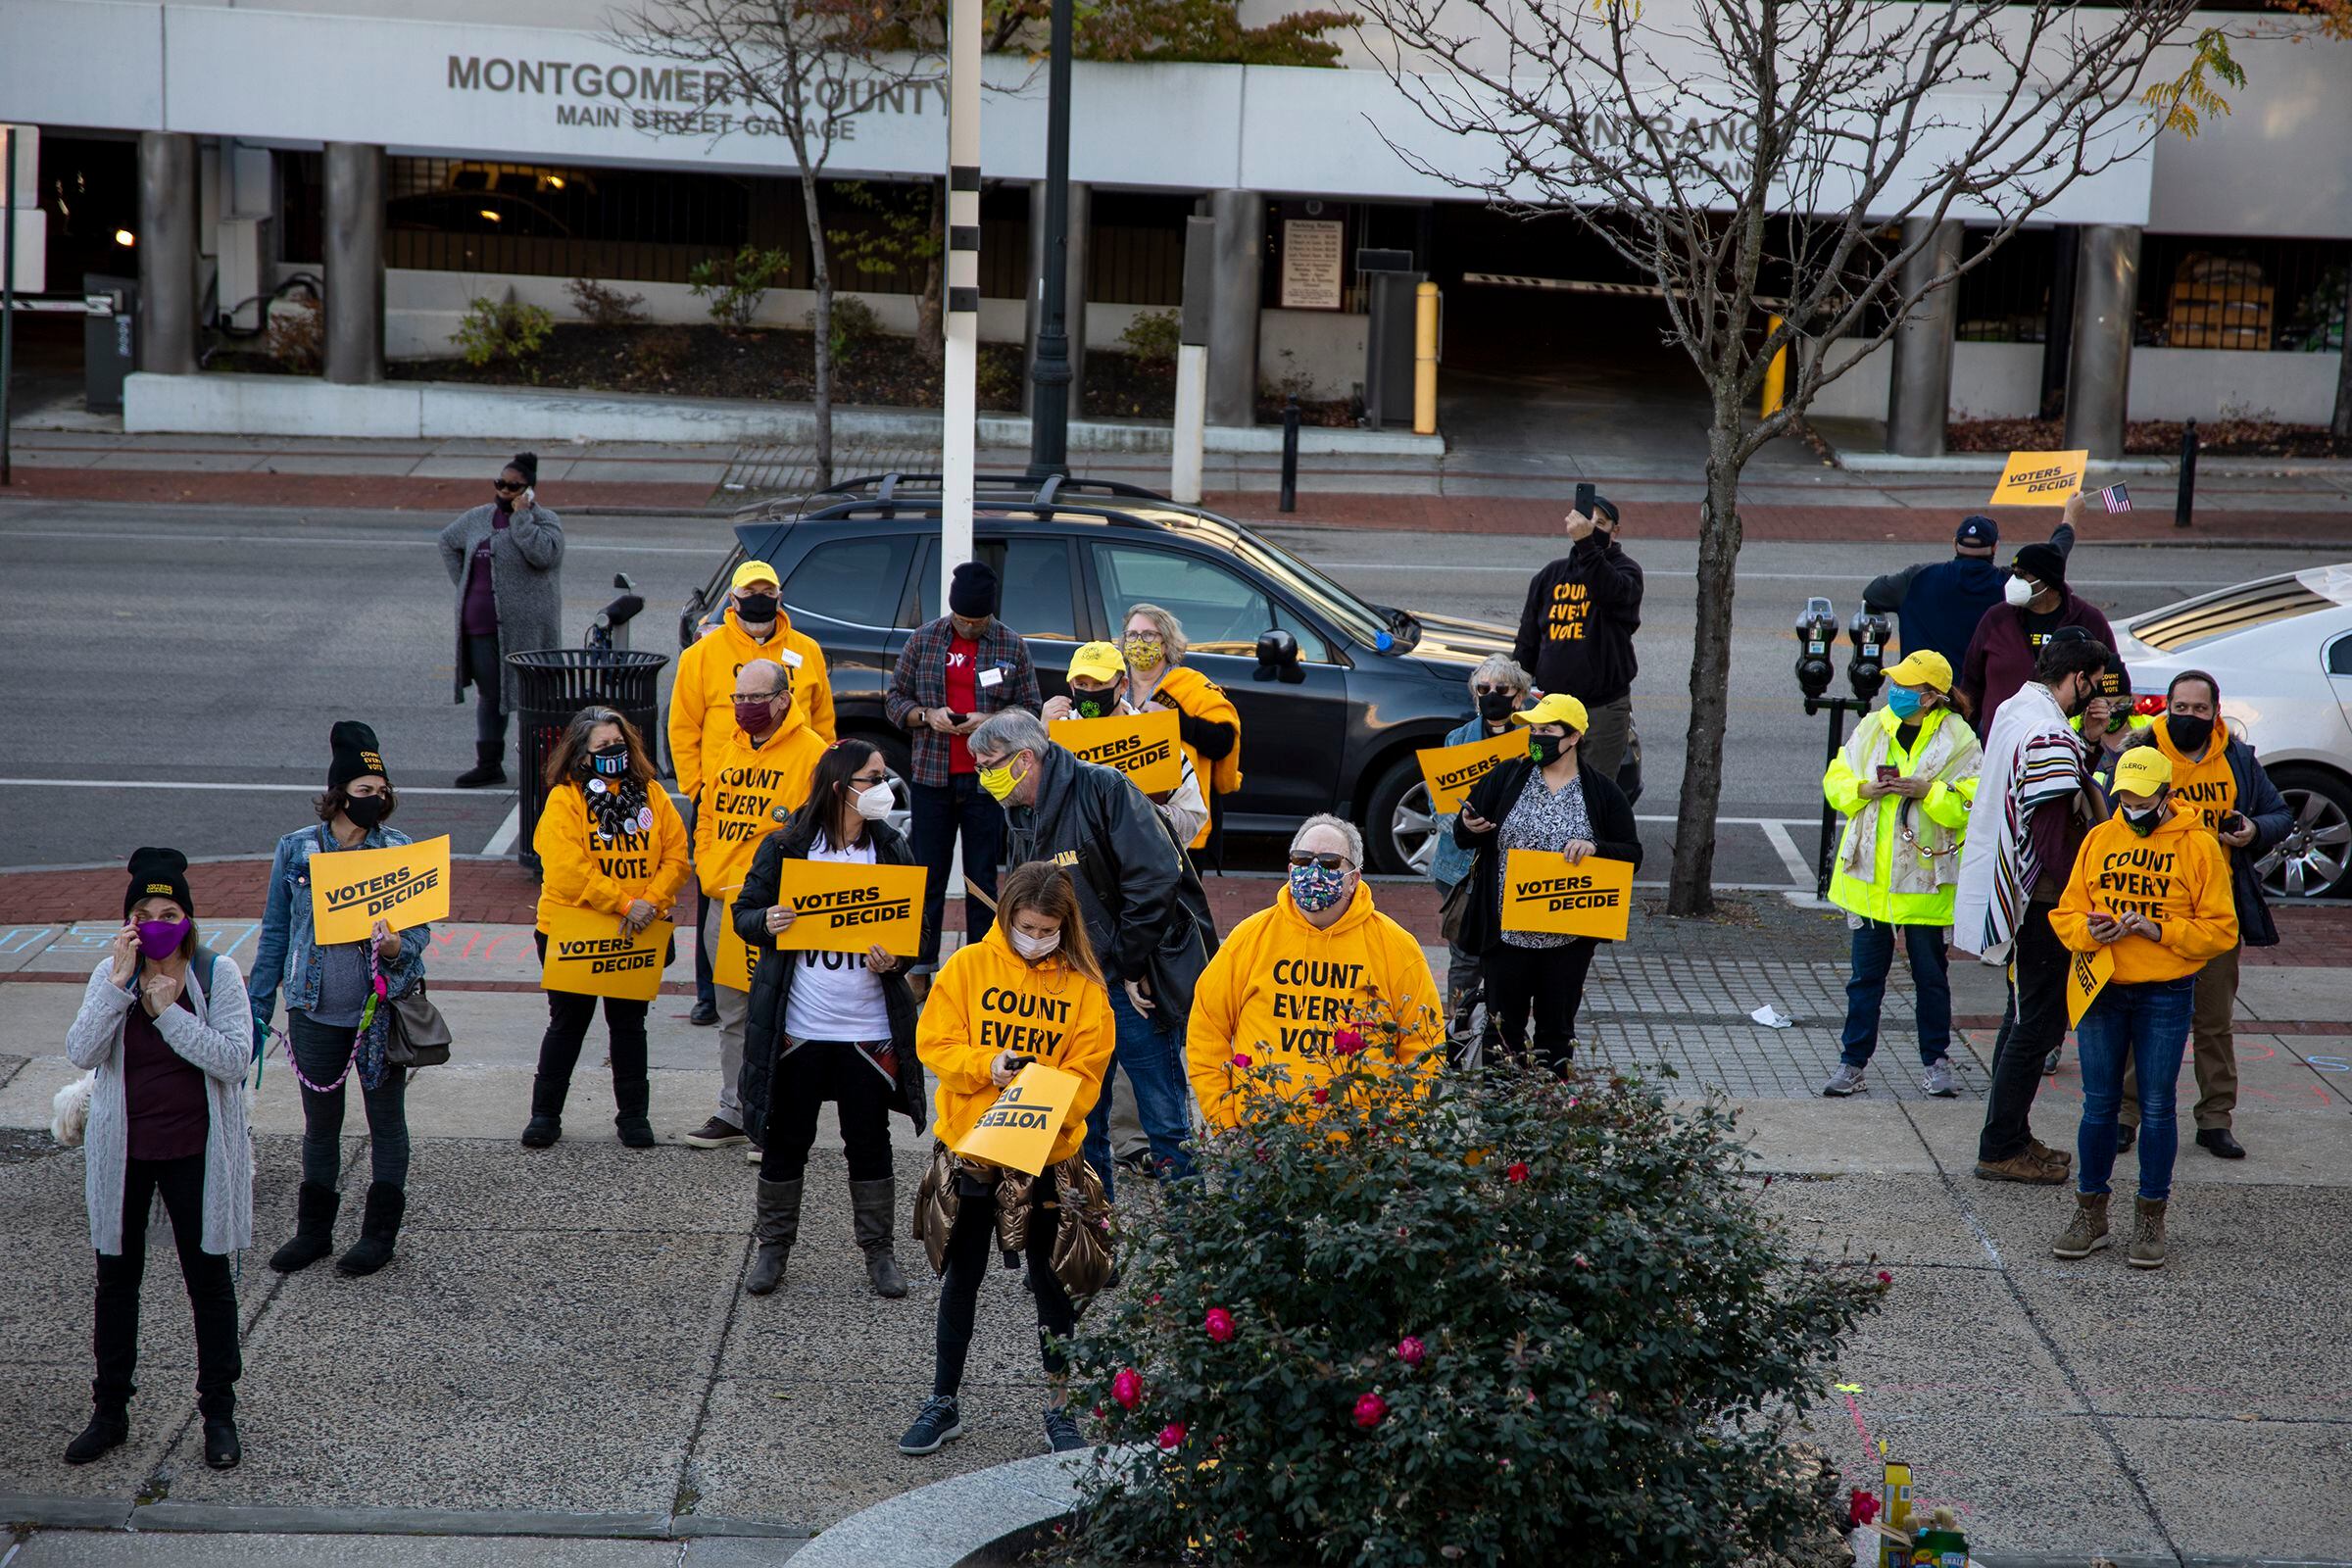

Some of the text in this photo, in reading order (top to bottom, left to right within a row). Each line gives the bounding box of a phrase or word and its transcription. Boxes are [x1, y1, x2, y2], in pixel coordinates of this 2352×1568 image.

[448, 55, 764, 107] MONTGOMERY
[557, 105, 856, 140] MAIN STREET GAAGE
[1568, 113, 1792, 155] ENTRANC
[2009, 466, 2062, 483] VOTERS
[2028, 476, 2078, 493] DECIDE
[1553, 583, 1588, 600] COUN
[595, 753, 628, 774] VOTE
[1115, 744, 1170, 773] ECIDE
[1435, 754, 1501, 787] VOTERS
[2121, 762, 2148, 771] CLERGY
[719, 767, 784, 790] COUNT
[714, 791, 772, 817] EVERY
[2176, 781, 2229, 803] OUNT
[2103, 848, 2176, 873] COUNT
[324, 866, 411, 906] VOTERS
[368, 873, 439, 917] DECIDE
[1515, 875, 1593, 897] VOTERS
[2099, 871, 2171, 899] EVERY
[792, 886, 880, 910] VOTERS
[1548, 894, 1620, 912] DECIDE
[830, 905, 910, 929] DECIDE
[559, 937, 635, 956] VOTERS
[591, 954, 656, 974] DECIDE
[1273, 959, 1364, 990] COUNT
[981, 986, 1072, 1024] COUNT
[1272, 993, 1355, 1023] EVERY
[980, 1019, 1064, 1057] EVERY
[1280, 1027, 1338, 1055] VOT
